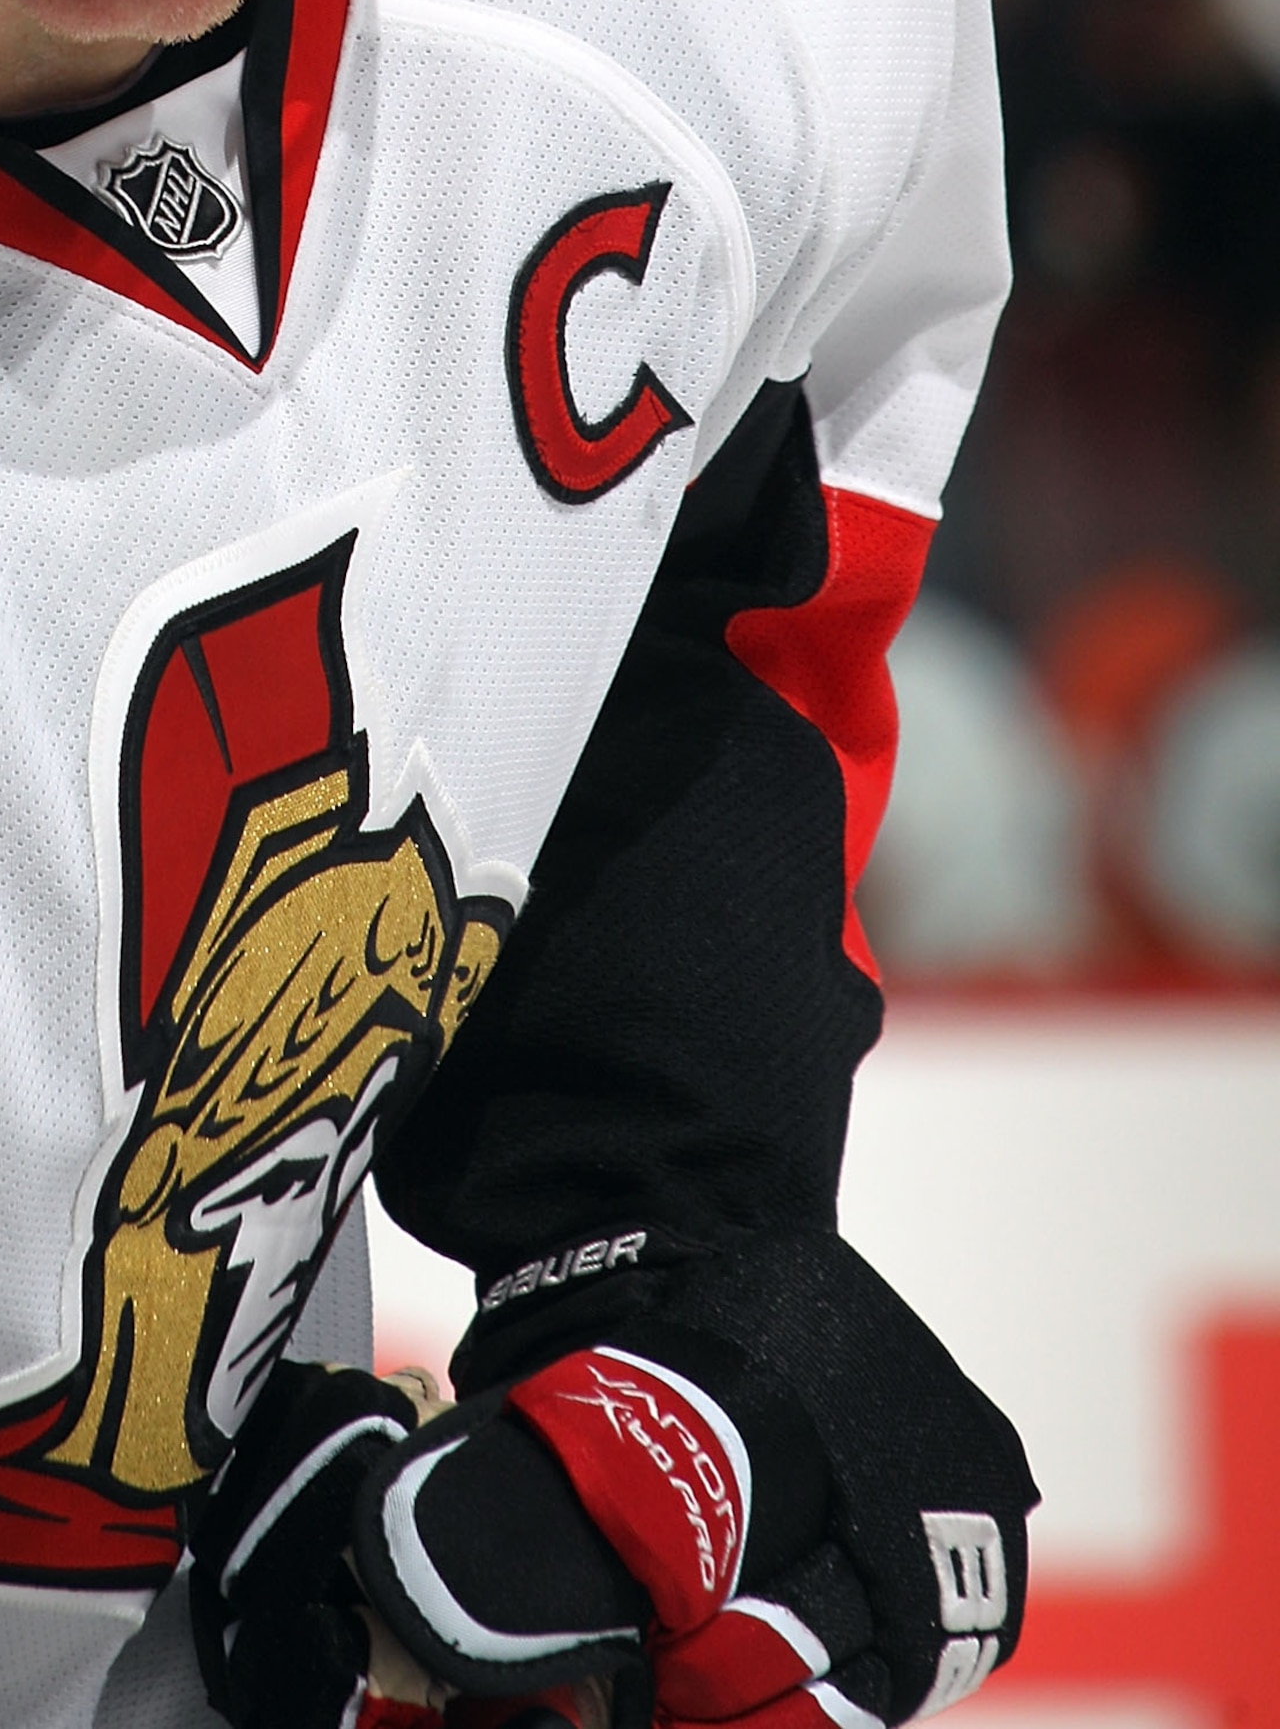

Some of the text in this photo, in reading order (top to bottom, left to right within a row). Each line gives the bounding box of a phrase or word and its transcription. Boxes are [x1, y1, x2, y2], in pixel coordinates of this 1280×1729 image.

[153, 166, 195, 243] NHL
[504, 181, 696, 504] C
[481, 1231, 648, 1314] BAUER
[585, 1362, 738, 1578] VAPOR
[668, 1475, 716, 1593] PRO
